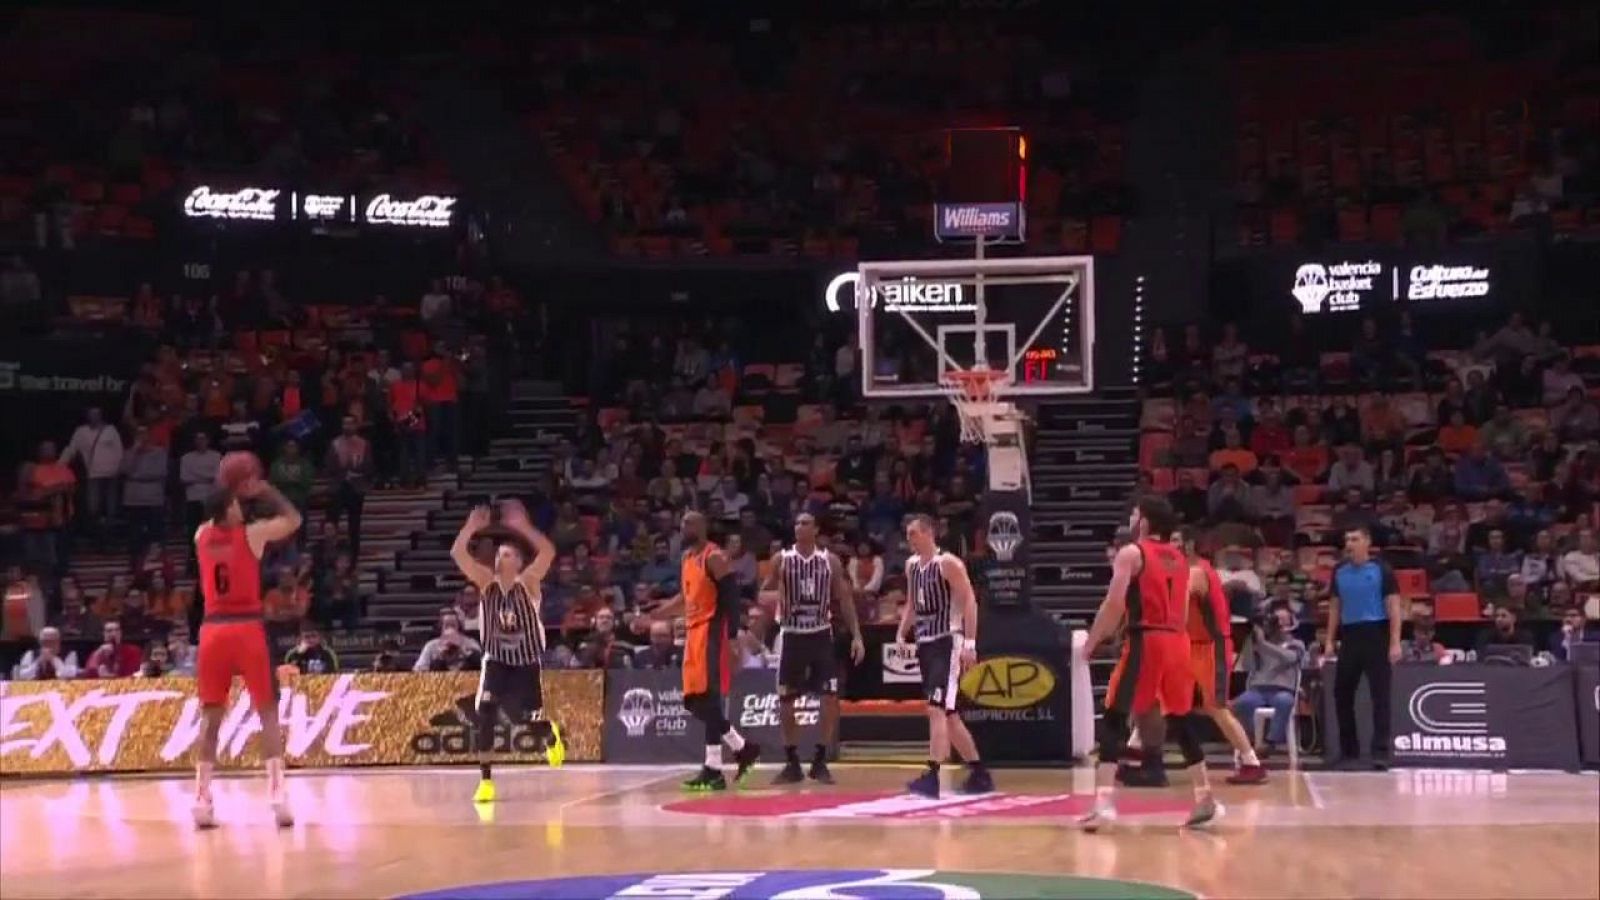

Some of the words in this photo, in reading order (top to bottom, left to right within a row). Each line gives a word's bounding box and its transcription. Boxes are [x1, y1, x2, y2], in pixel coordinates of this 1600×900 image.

[944, 206, 1010, 229] Williams
[1328, 260, 1381, 276] valencia
[1410, 265, 1473, 282] Cultura
[884, 276, 963, 304] aiken
[1329, 277, 1373, 291] basket
[1408, 282, 1490, 300] Esfuerzo
[1329, 291, 1360, 304] club
[214, 562, 229, 595] 6
[974, 661, 1039, 699] AP
[1394, 732, 1508, 751] elmusa
